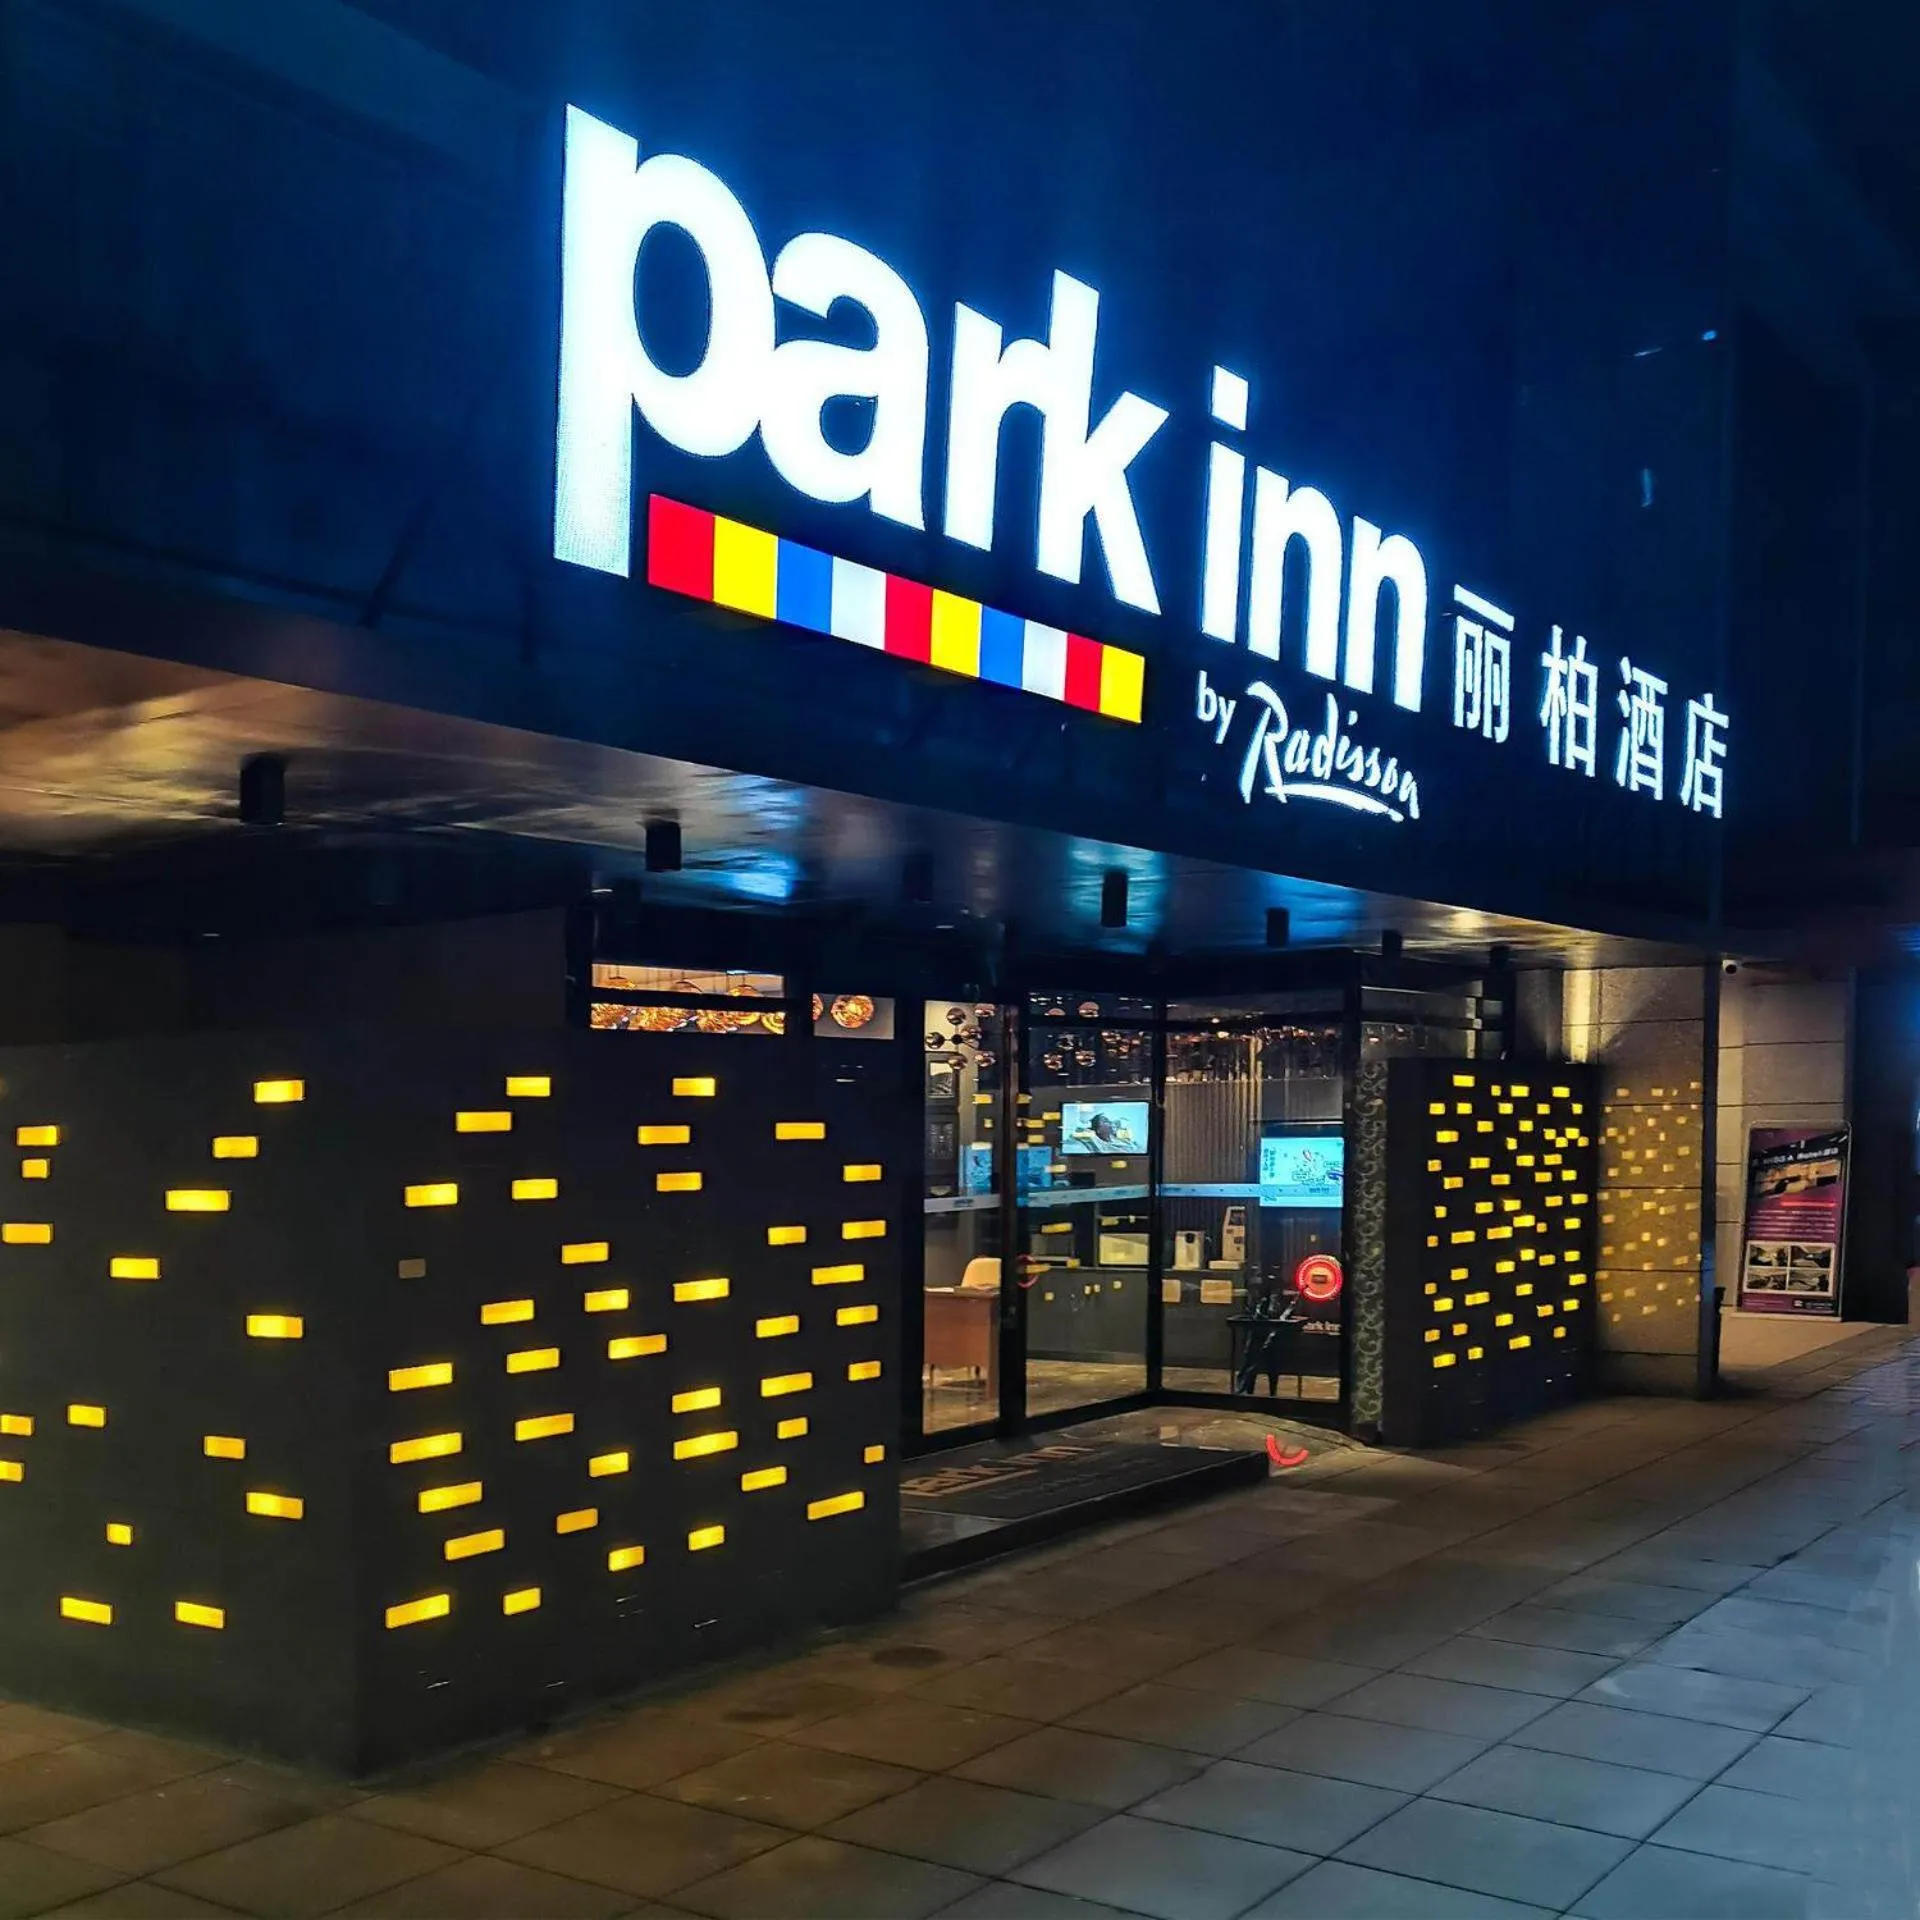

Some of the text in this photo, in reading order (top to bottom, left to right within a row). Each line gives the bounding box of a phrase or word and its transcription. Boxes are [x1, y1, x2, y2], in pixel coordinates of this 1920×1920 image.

[553, 103, 1429, 714] park inn
[1196, 669, 1421, 823] by Radisson
[1453, 583, 1730, 820] 丽柏酒店
